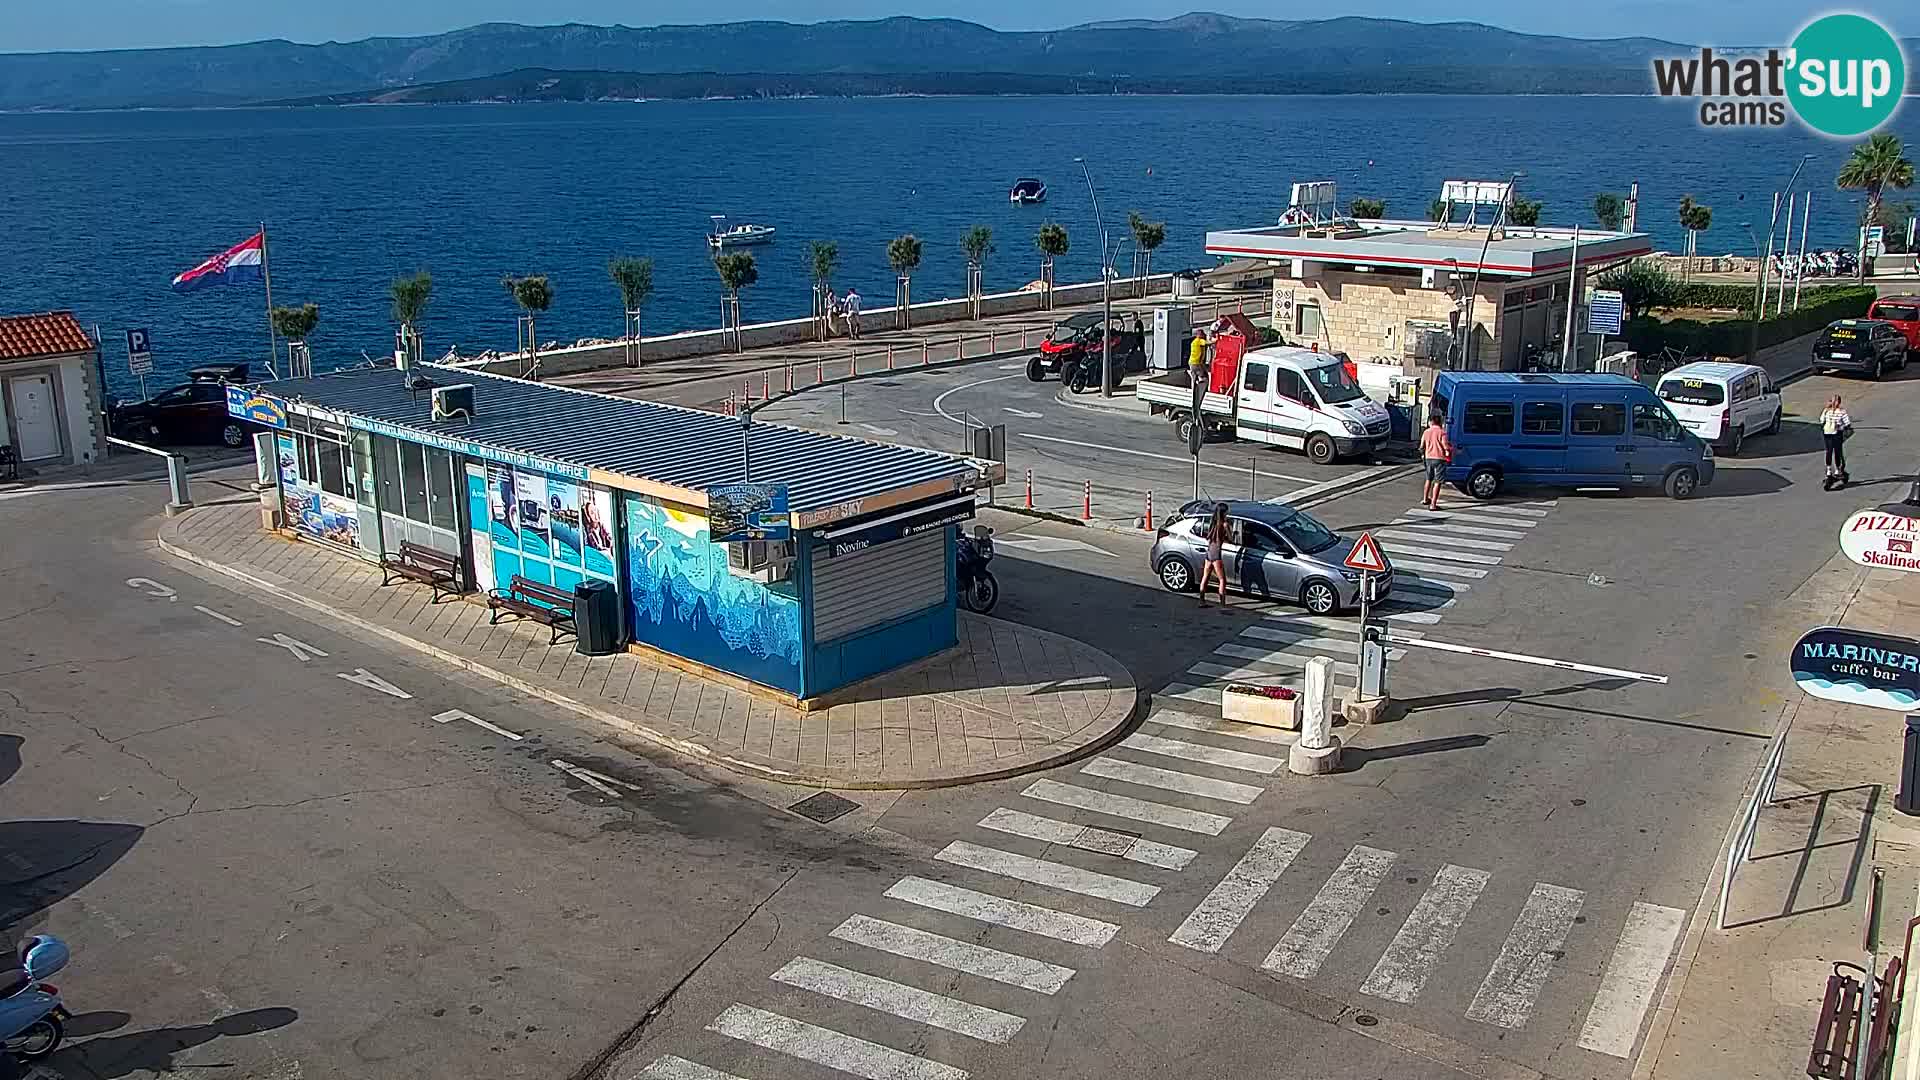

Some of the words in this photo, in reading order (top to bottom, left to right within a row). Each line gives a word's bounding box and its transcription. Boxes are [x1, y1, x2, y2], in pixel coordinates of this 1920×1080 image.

[132, 332, 144, 350] P
[1684, 380, 1702, 389] TAXI
[480, 447, 495, 459] BUS
[496, 450, 528, 466] STATION
[530, 457, 556, 472] TICKET
[556, 463, 584, 478] OFFICE
[1851, 516, 1920, 534] PIZZE
[1884, 531, 1919, 541] GRILL
[1802, 643, 1920, 673] MARINER
[1832, 663, 1869, 677] caffe
[1873, 666, 1900, 680] bar
